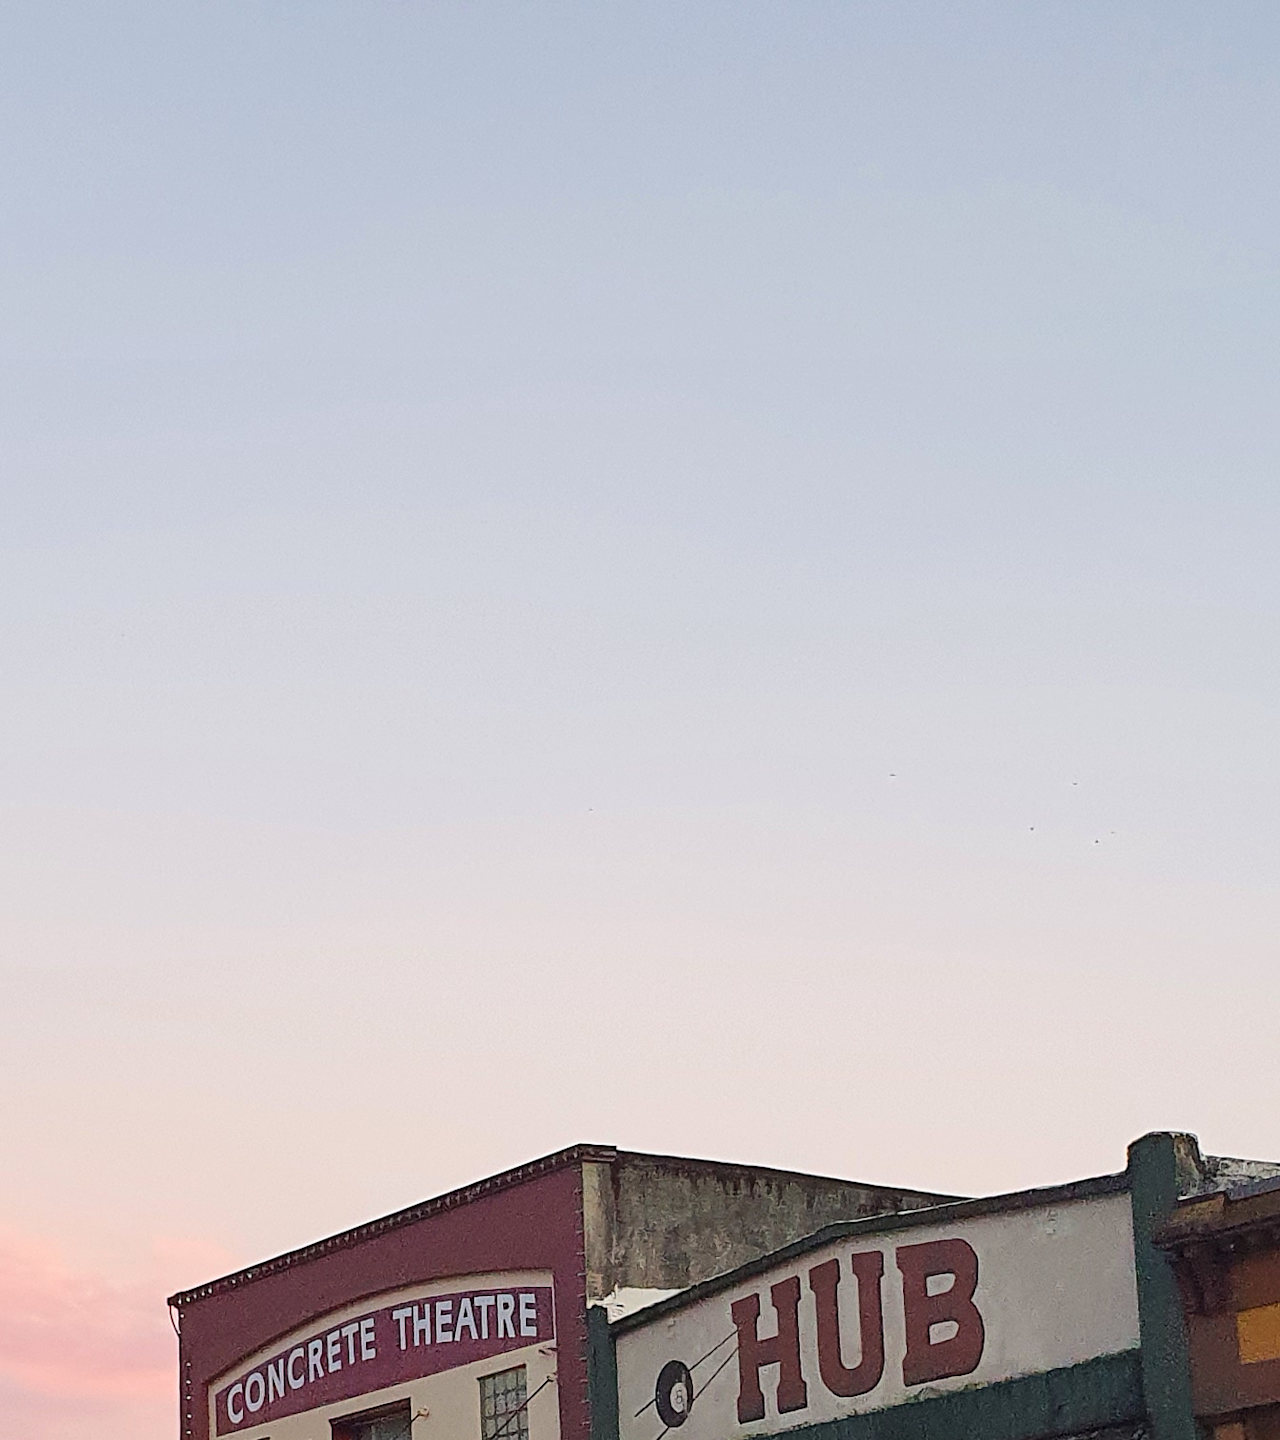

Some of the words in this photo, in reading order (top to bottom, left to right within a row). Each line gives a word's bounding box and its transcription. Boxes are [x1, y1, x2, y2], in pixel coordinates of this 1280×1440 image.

[226, 1317, 377, 1424] CONCRETE
[392, 1293, 538, 1350] THEATRE
[730, 1238, 985, 1424] HUB
